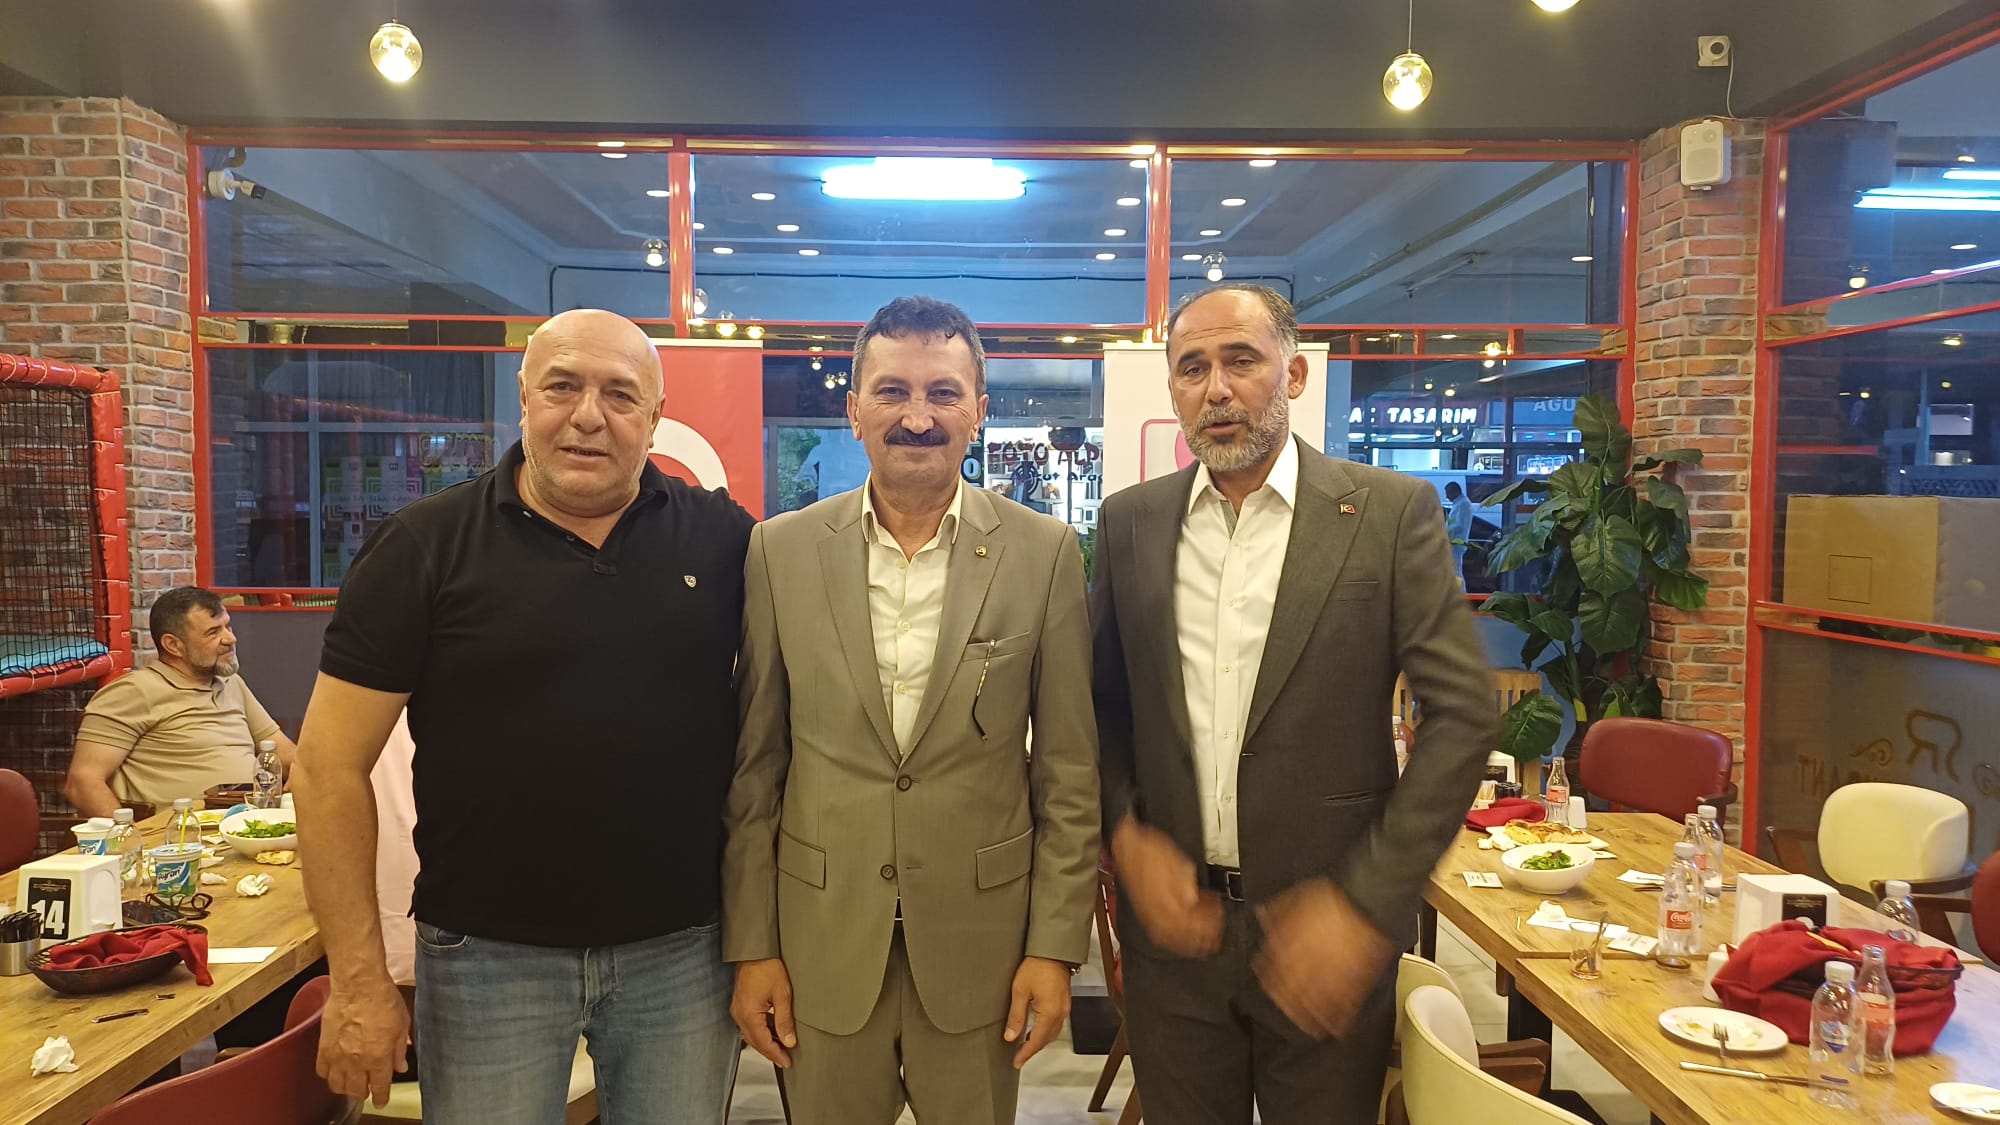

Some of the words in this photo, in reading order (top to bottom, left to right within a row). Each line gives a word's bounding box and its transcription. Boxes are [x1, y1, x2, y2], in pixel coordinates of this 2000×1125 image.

[1387, 407, 1477, 424] TASARIM
[987, 441, 1049, 467] FOTO
[1057, 441, 1104, 467] ALP
[158, 868, 181, 881] Ayran
[31, 899, 66, 936] 14
